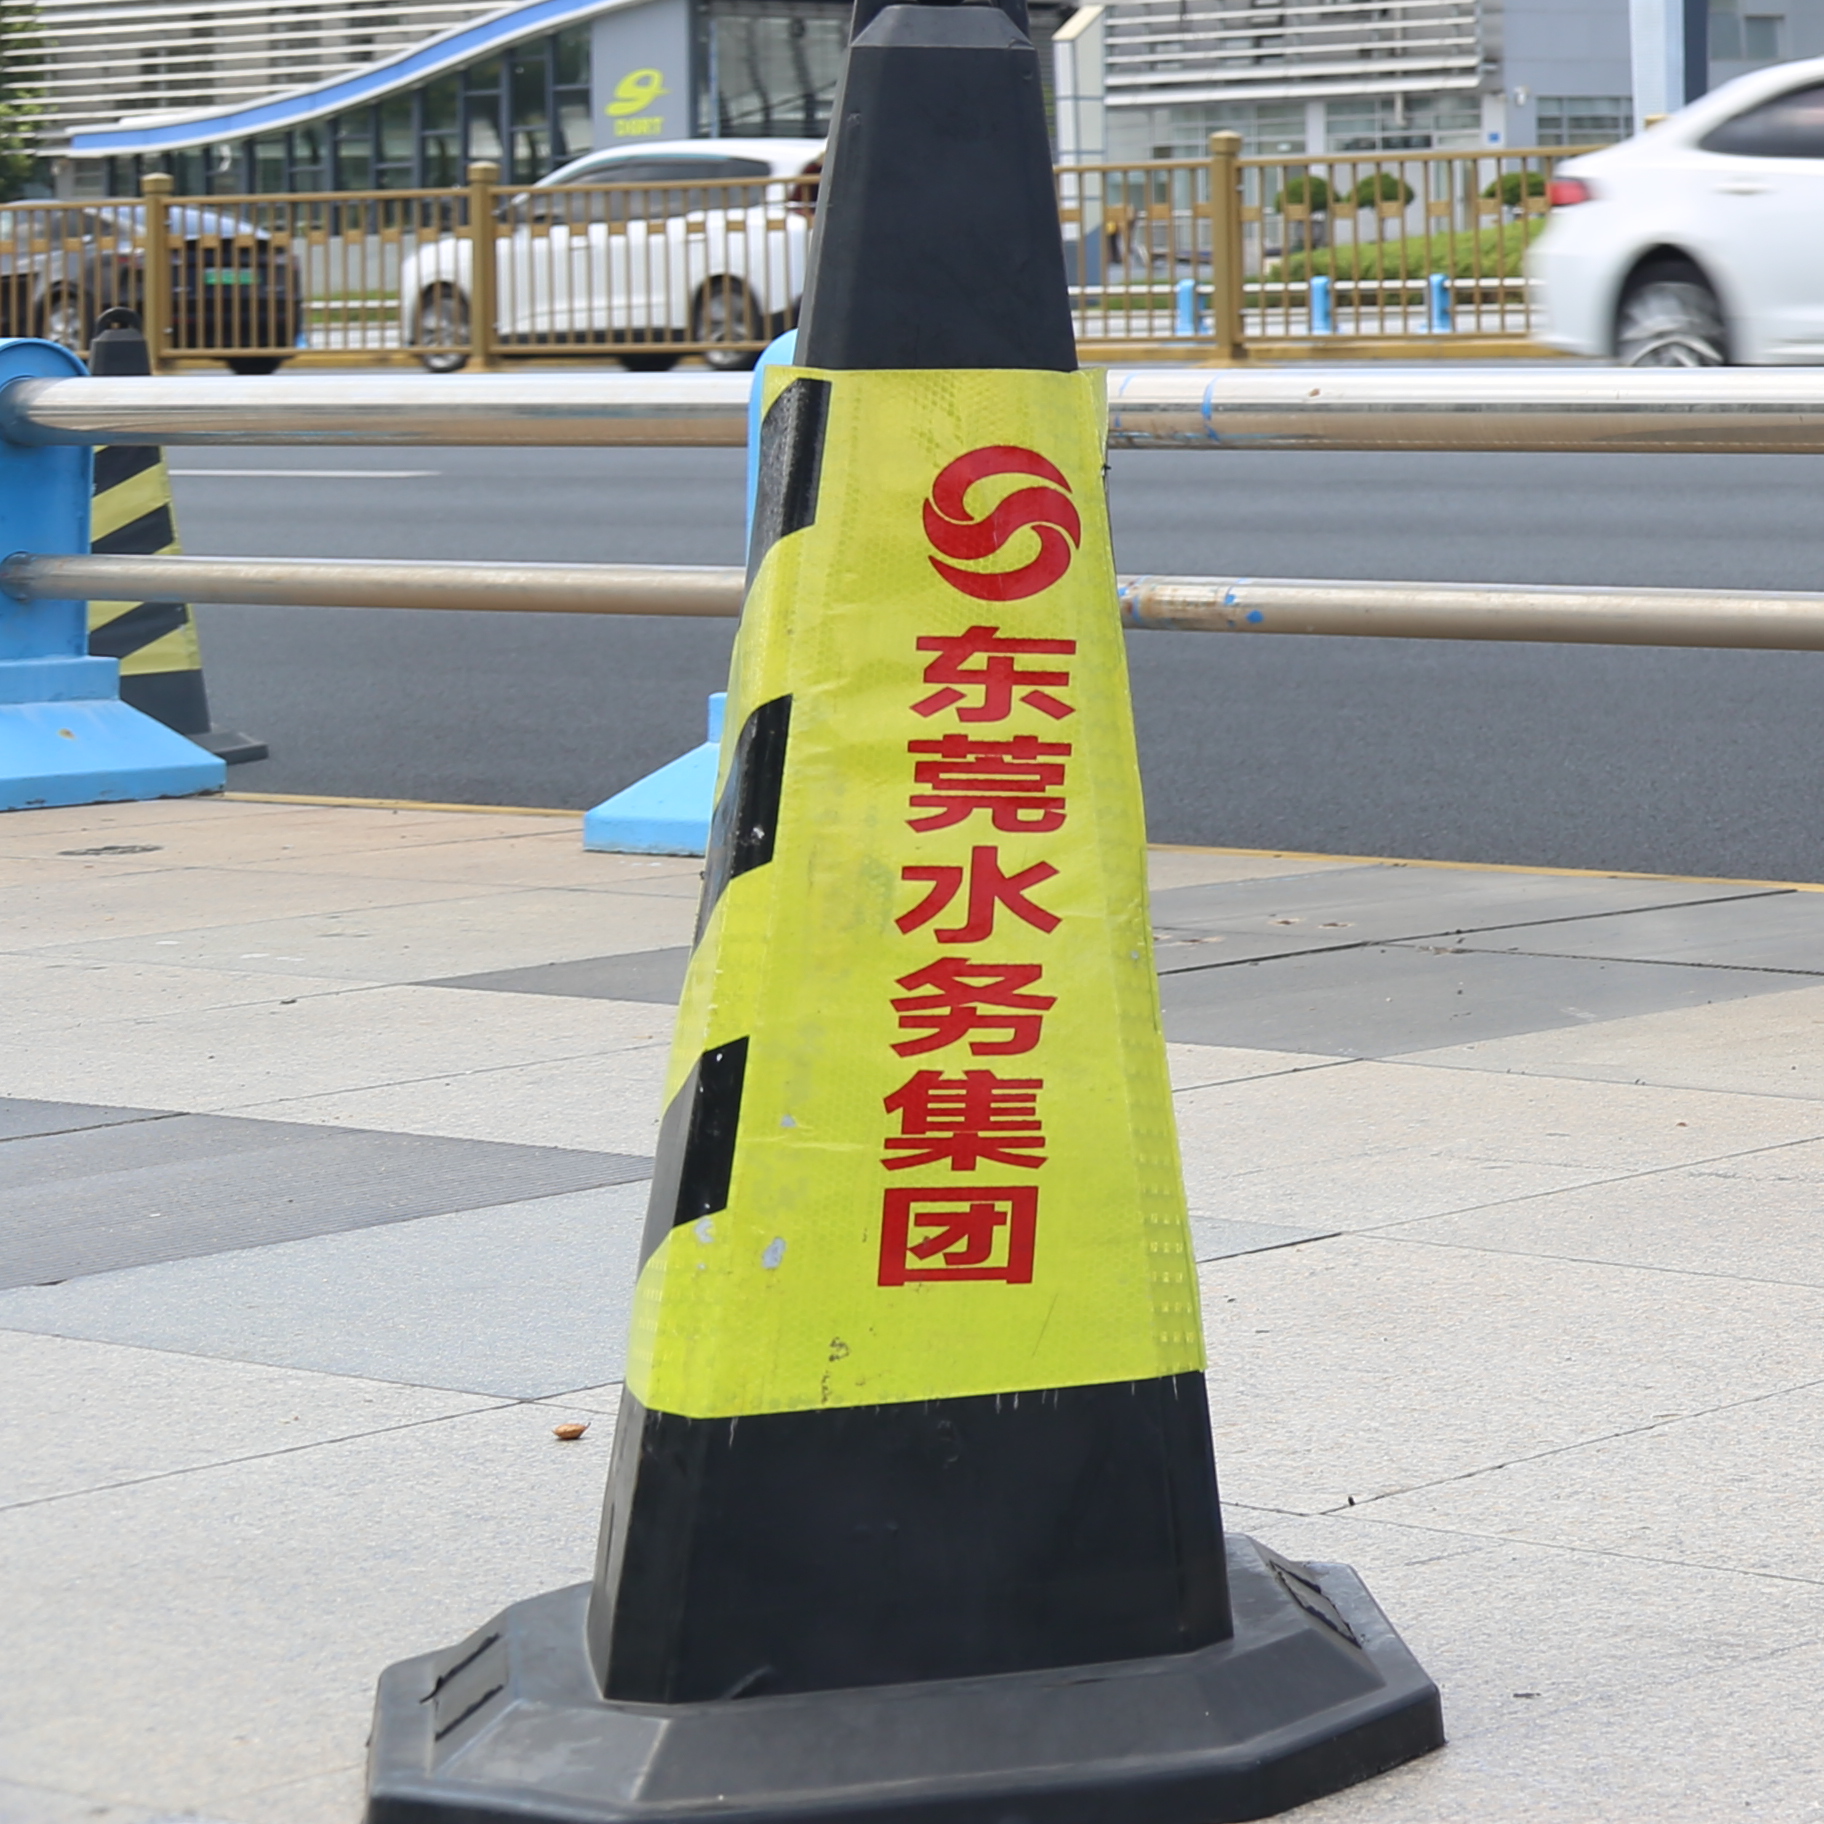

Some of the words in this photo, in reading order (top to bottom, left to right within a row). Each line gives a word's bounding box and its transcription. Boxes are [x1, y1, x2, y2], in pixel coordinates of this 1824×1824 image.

[876, 625, 1077, 1288] 东莞水务集团
